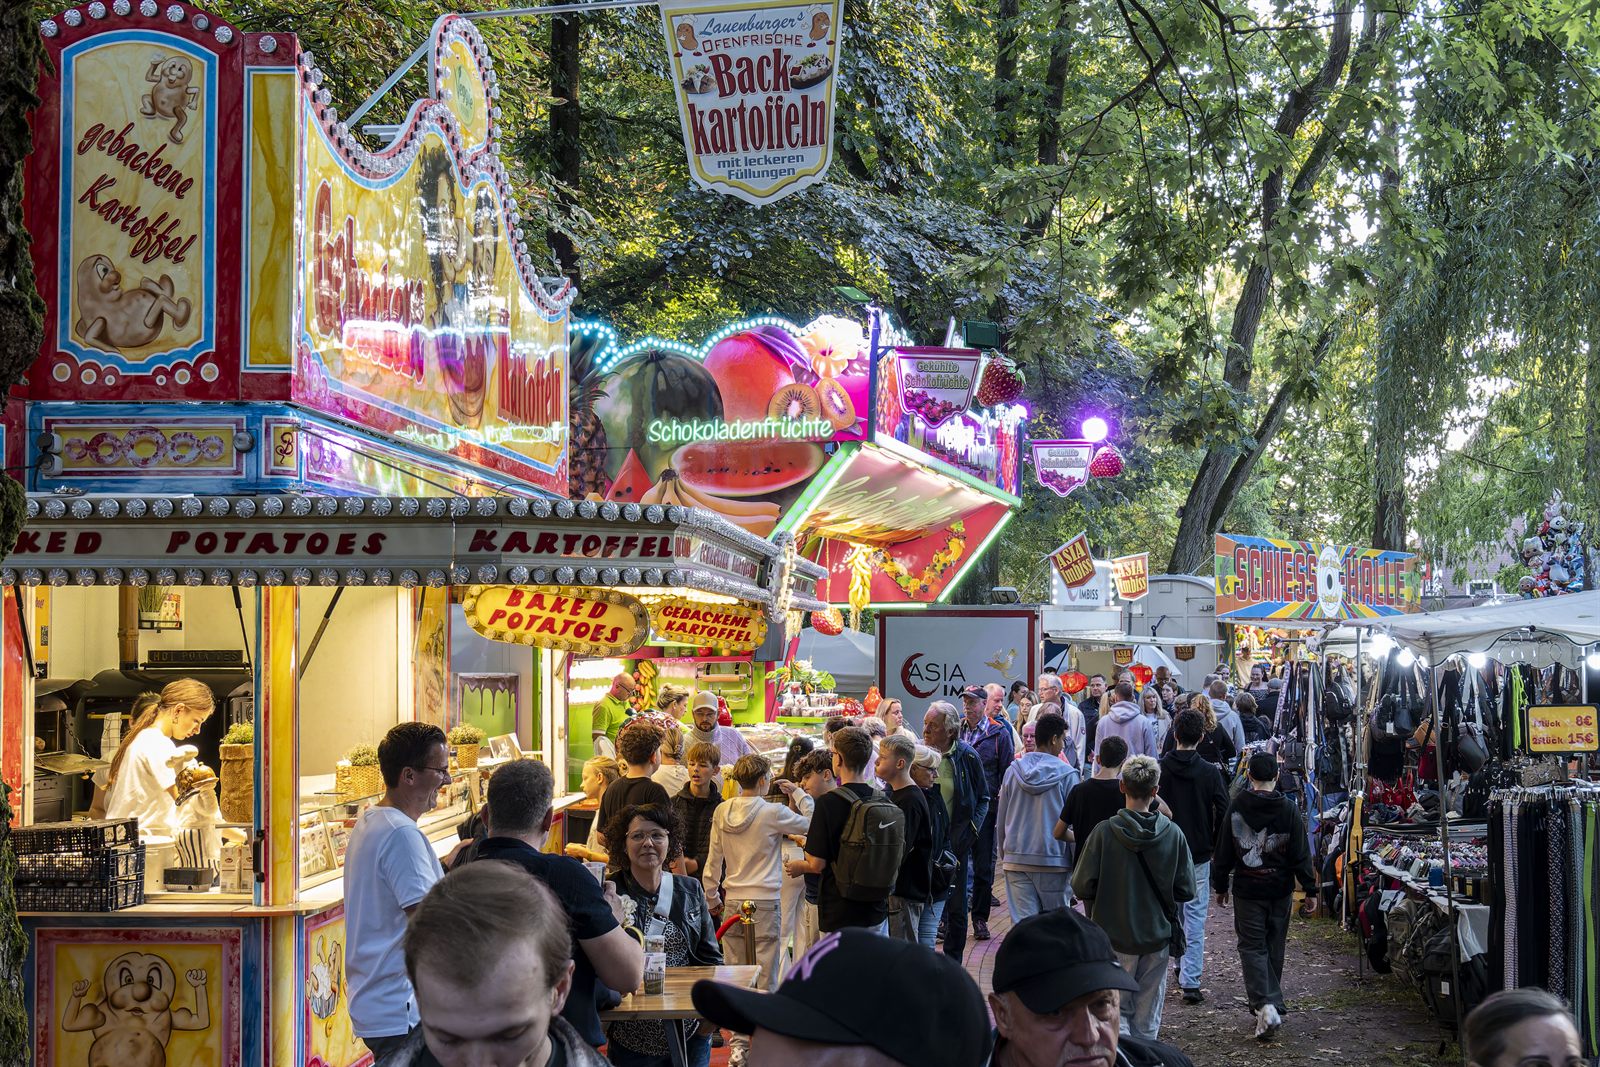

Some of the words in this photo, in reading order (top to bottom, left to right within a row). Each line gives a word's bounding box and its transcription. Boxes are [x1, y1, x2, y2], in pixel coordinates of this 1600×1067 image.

[702, 33, 803, 53] OFENFRISCHE
[709, 48, 802, 98] Back-
[688, 94, 826, 155] kartoffeln
[77, 122, 194, 199] gebackene
[717, 156, 741, 169] mit
[744, 154, 805, 167] leckeren
[727, 167, 796, 181] Füllungen
[78, 173, 197, 264] Kartoffel
[648, 417, 834, 443] Schokoladenfrüchte
[13, 531, 102, 555] KED
[165, 531, 388, 555] POTATOES
[468, 529, 673, 559] KARTOFFEL
[1056, 542, 1086, 568] ASIA
[1060, 558, 1092, 584] Imbiss
[1118, 560, 1144, 577] ASIA
[1235, 545, 1318, 603] SCHIESS
[1079, 589, 1098, 600] IMBISS
[1118, 575, 1146, 593] Imbiss
[506, 588, 609, 619] BAKED
[488, 608, 624, 644] POTATOES
[663, 605, 752, 628] GEBACKENE
[665, 619, 752, 643] KARTOFFEL
[908, 663, 966, 682] ASIA
[1575, 715, 1592, 726] 8€
[1568, 733, 1593, 744] 15€
